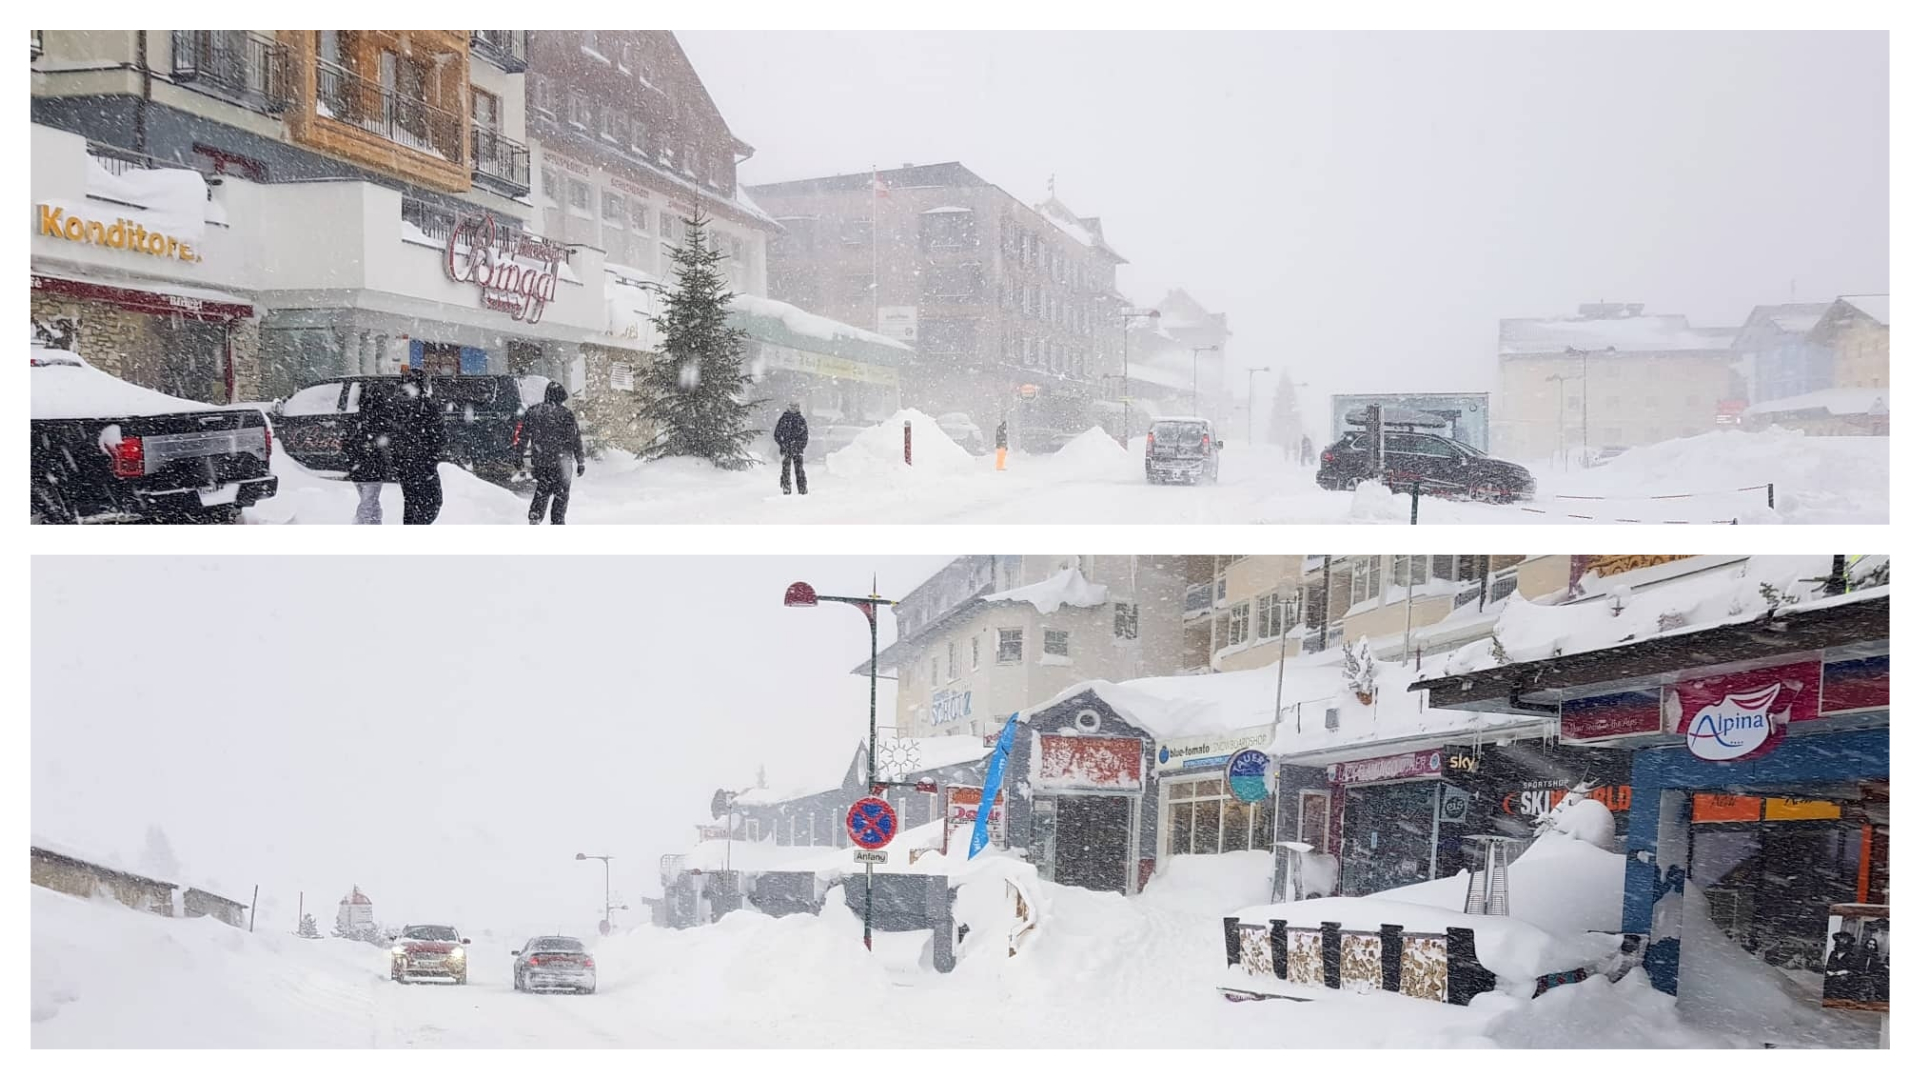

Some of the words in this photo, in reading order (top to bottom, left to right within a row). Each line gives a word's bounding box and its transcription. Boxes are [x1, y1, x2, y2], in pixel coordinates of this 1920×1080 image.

[36, 203, 203, 262] Konditore
[1689, 711, 1765, 749] Alpina
[1450, 752, 1475, 772] sky
[1523, 779, 1569, 790] SPORTSHOP
[1520, 785, 1633, 816] SKIWRLD
